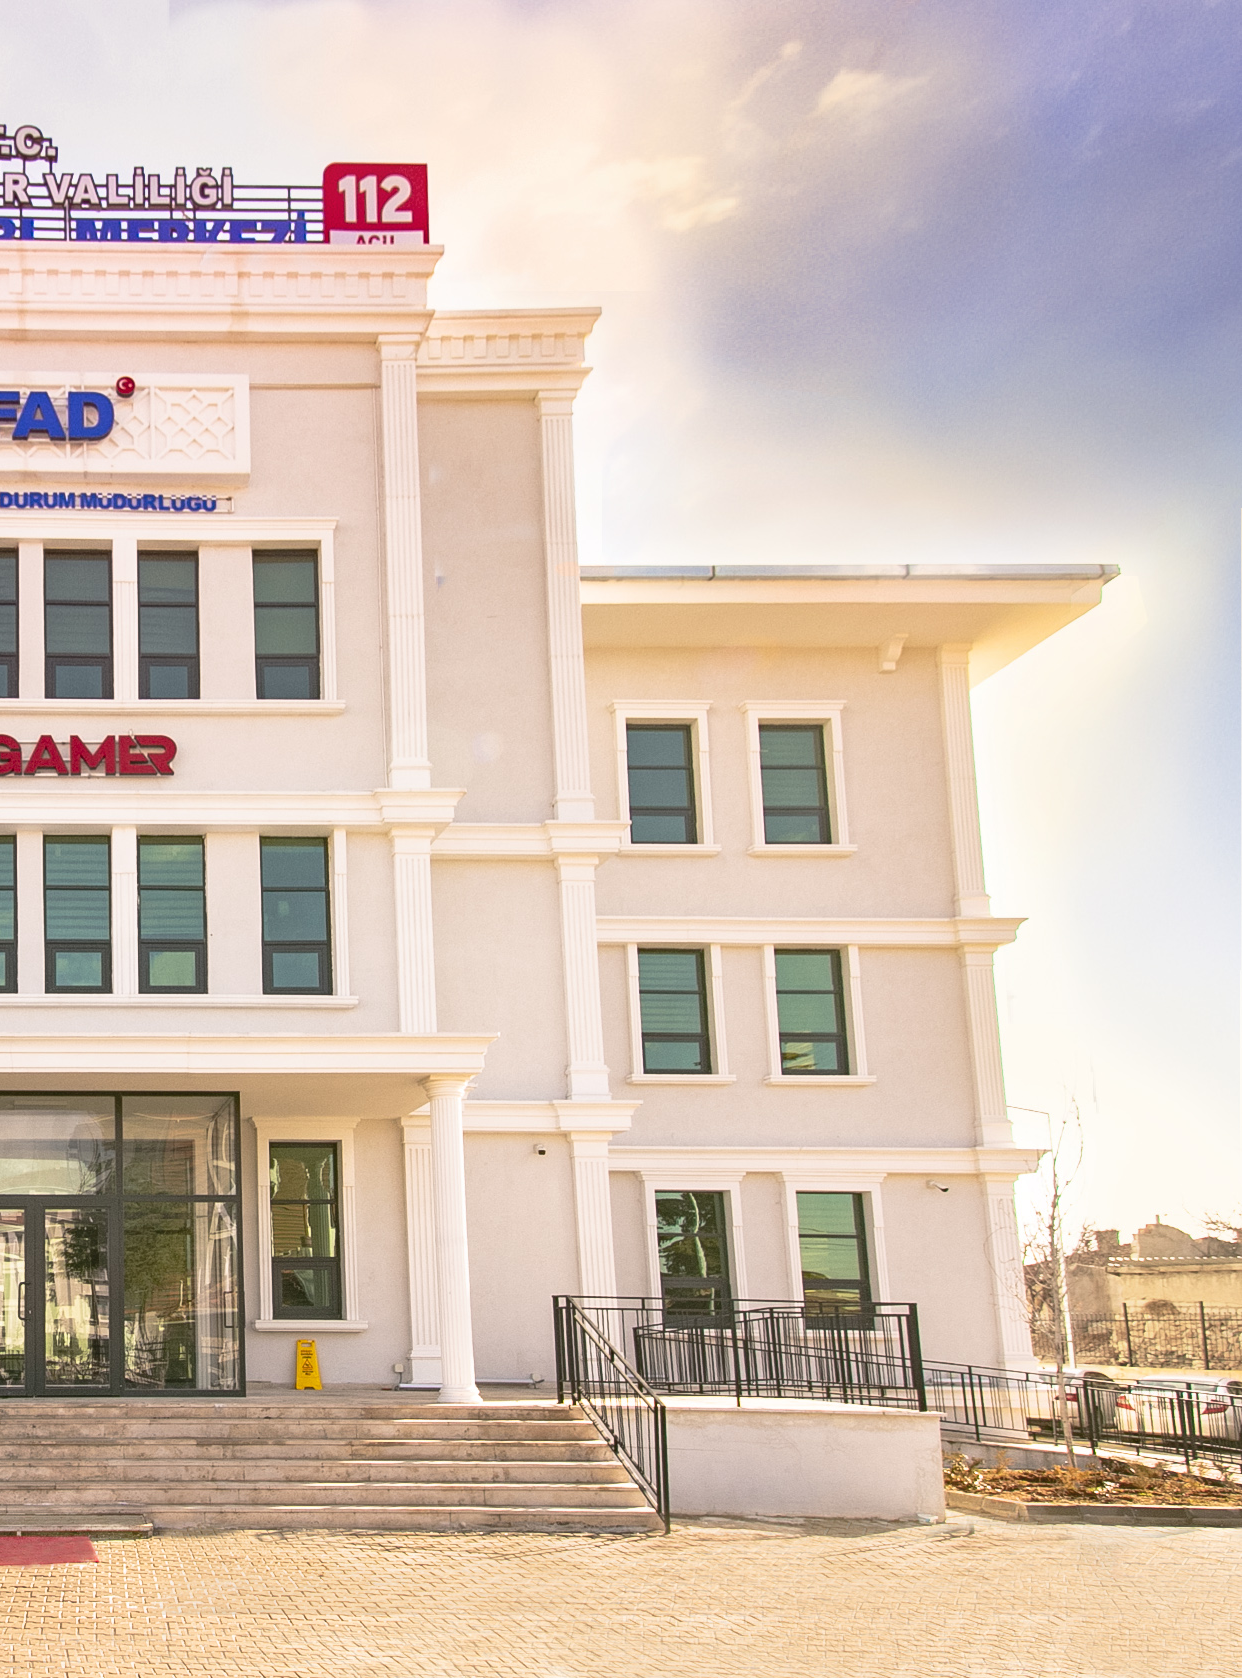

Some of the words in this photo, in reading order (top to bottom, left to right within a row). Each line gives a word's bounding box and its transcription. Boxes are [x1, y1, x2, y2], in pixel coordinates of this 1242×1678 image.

[42, 166, 234, 211] VALİLİĞİ
[337, 173, 413, 224] 112
[0, 492, 76, 509] DURUM
